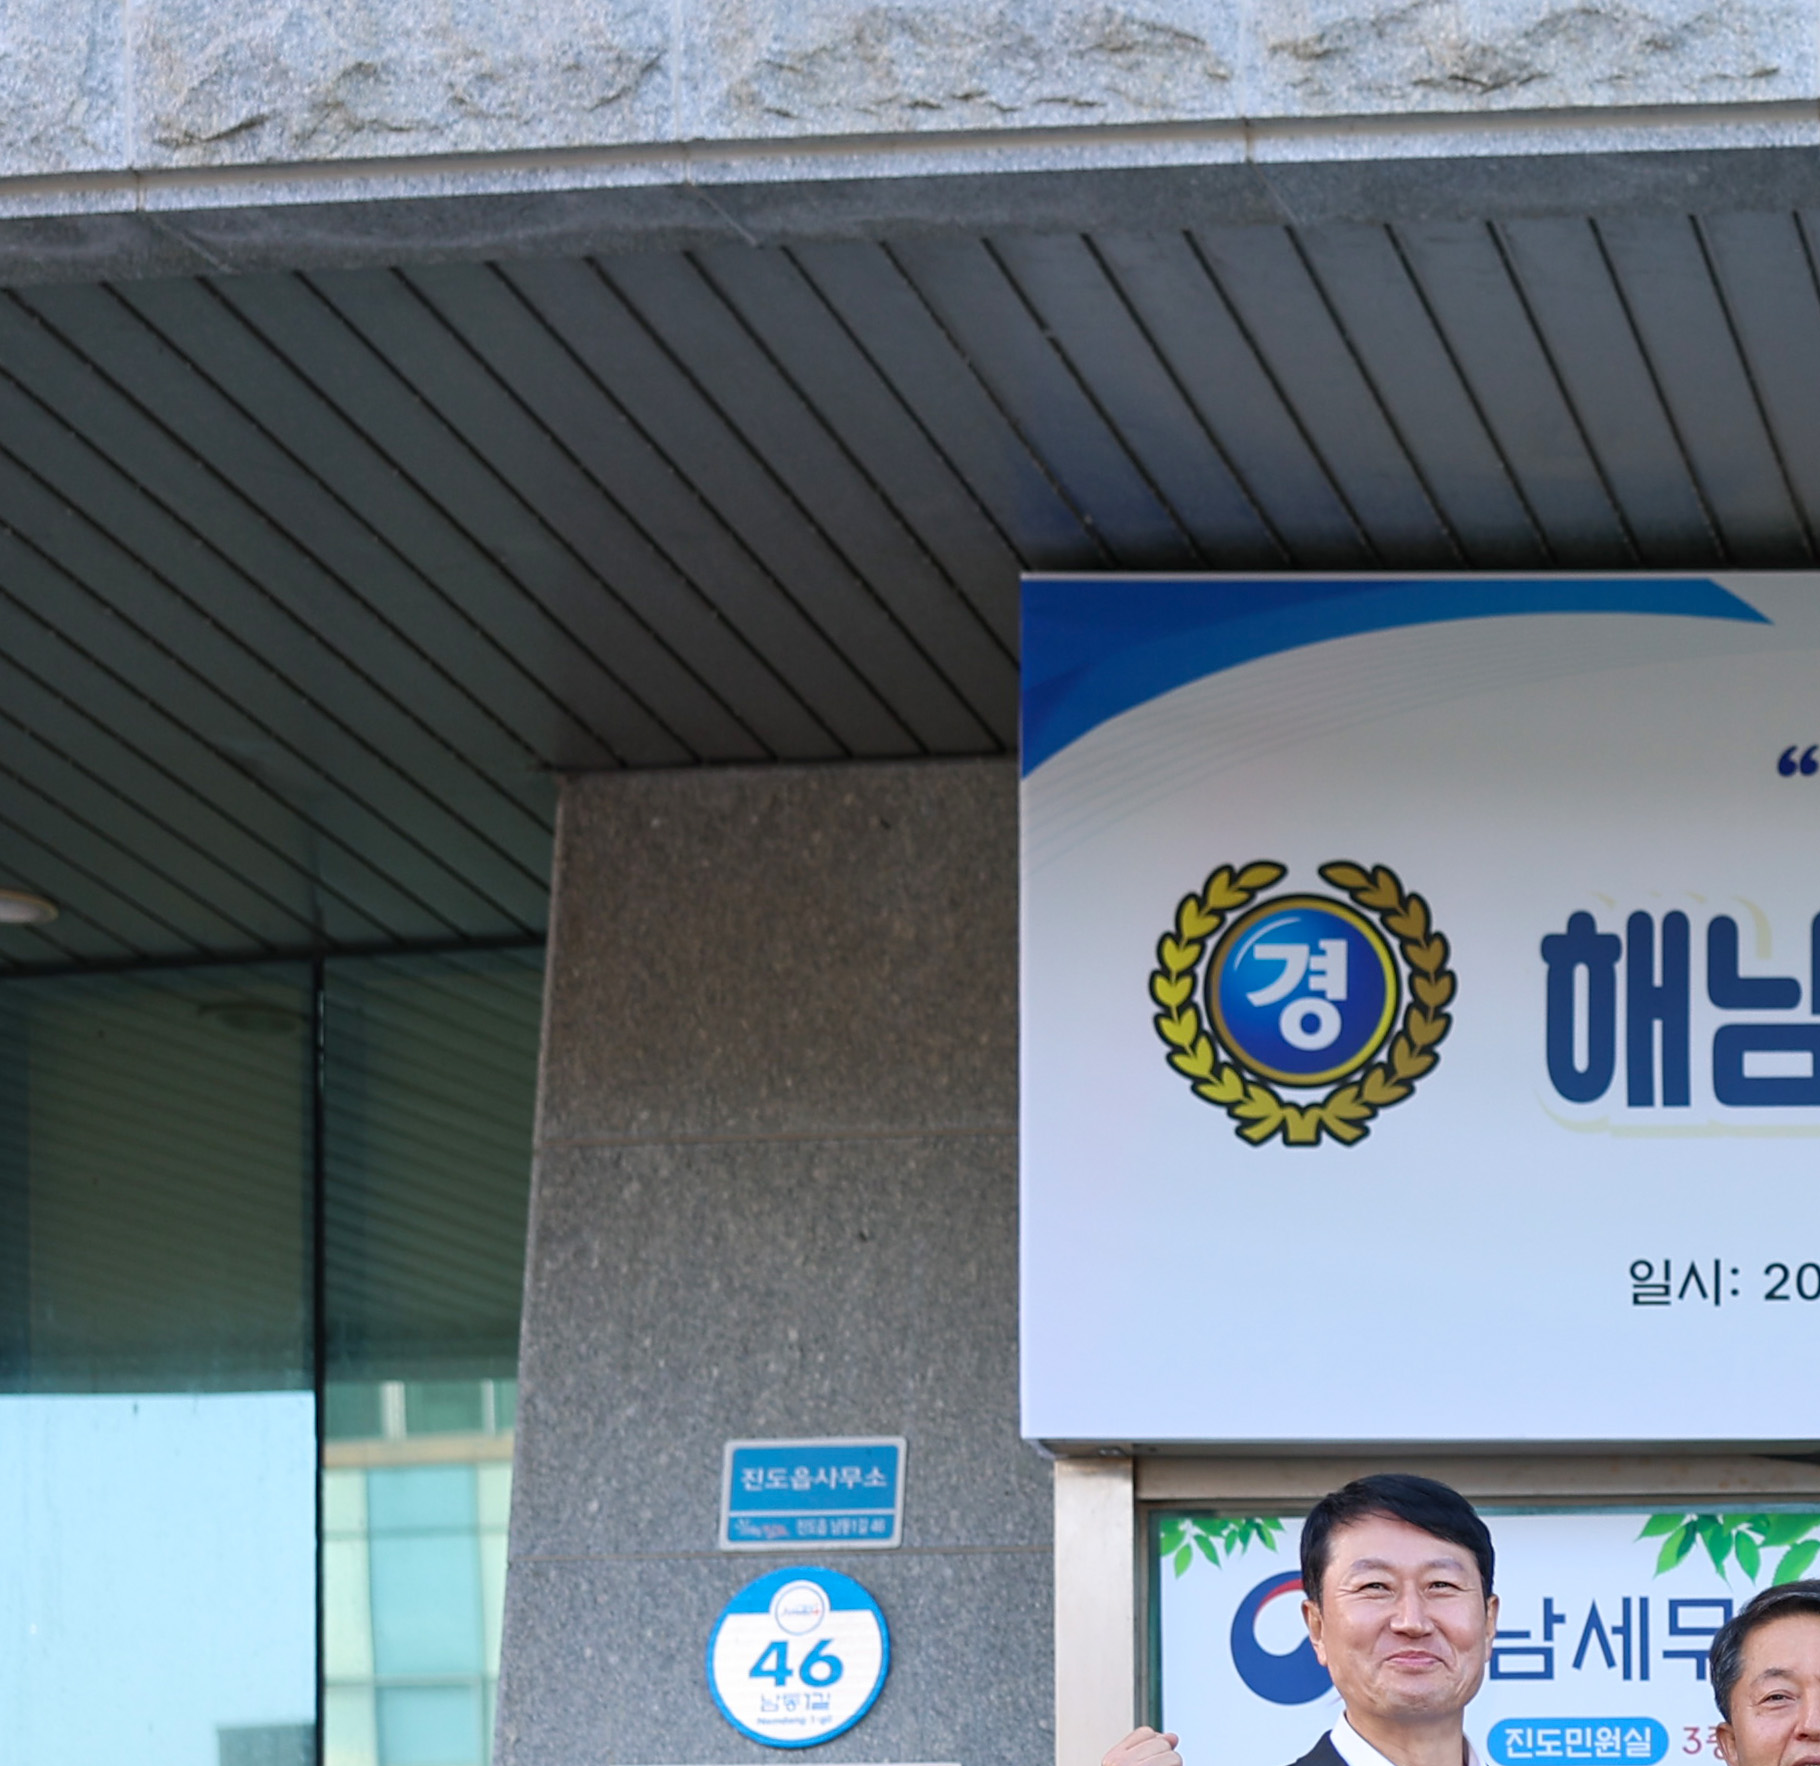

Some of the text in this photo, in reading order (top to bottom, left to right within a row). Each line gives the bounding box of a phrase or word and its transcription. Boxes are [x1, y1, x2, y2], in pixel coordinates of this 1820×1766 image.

[1246, 938, 1348, 1051] 경
[1628, 1256, 1741, 1308] 일시:
[741, 1466, 888, 1492] 진도읍사무소
[749, 1638, 844, 1688] 46
[1505, 1726, 1652, 1759] 진도민원실
